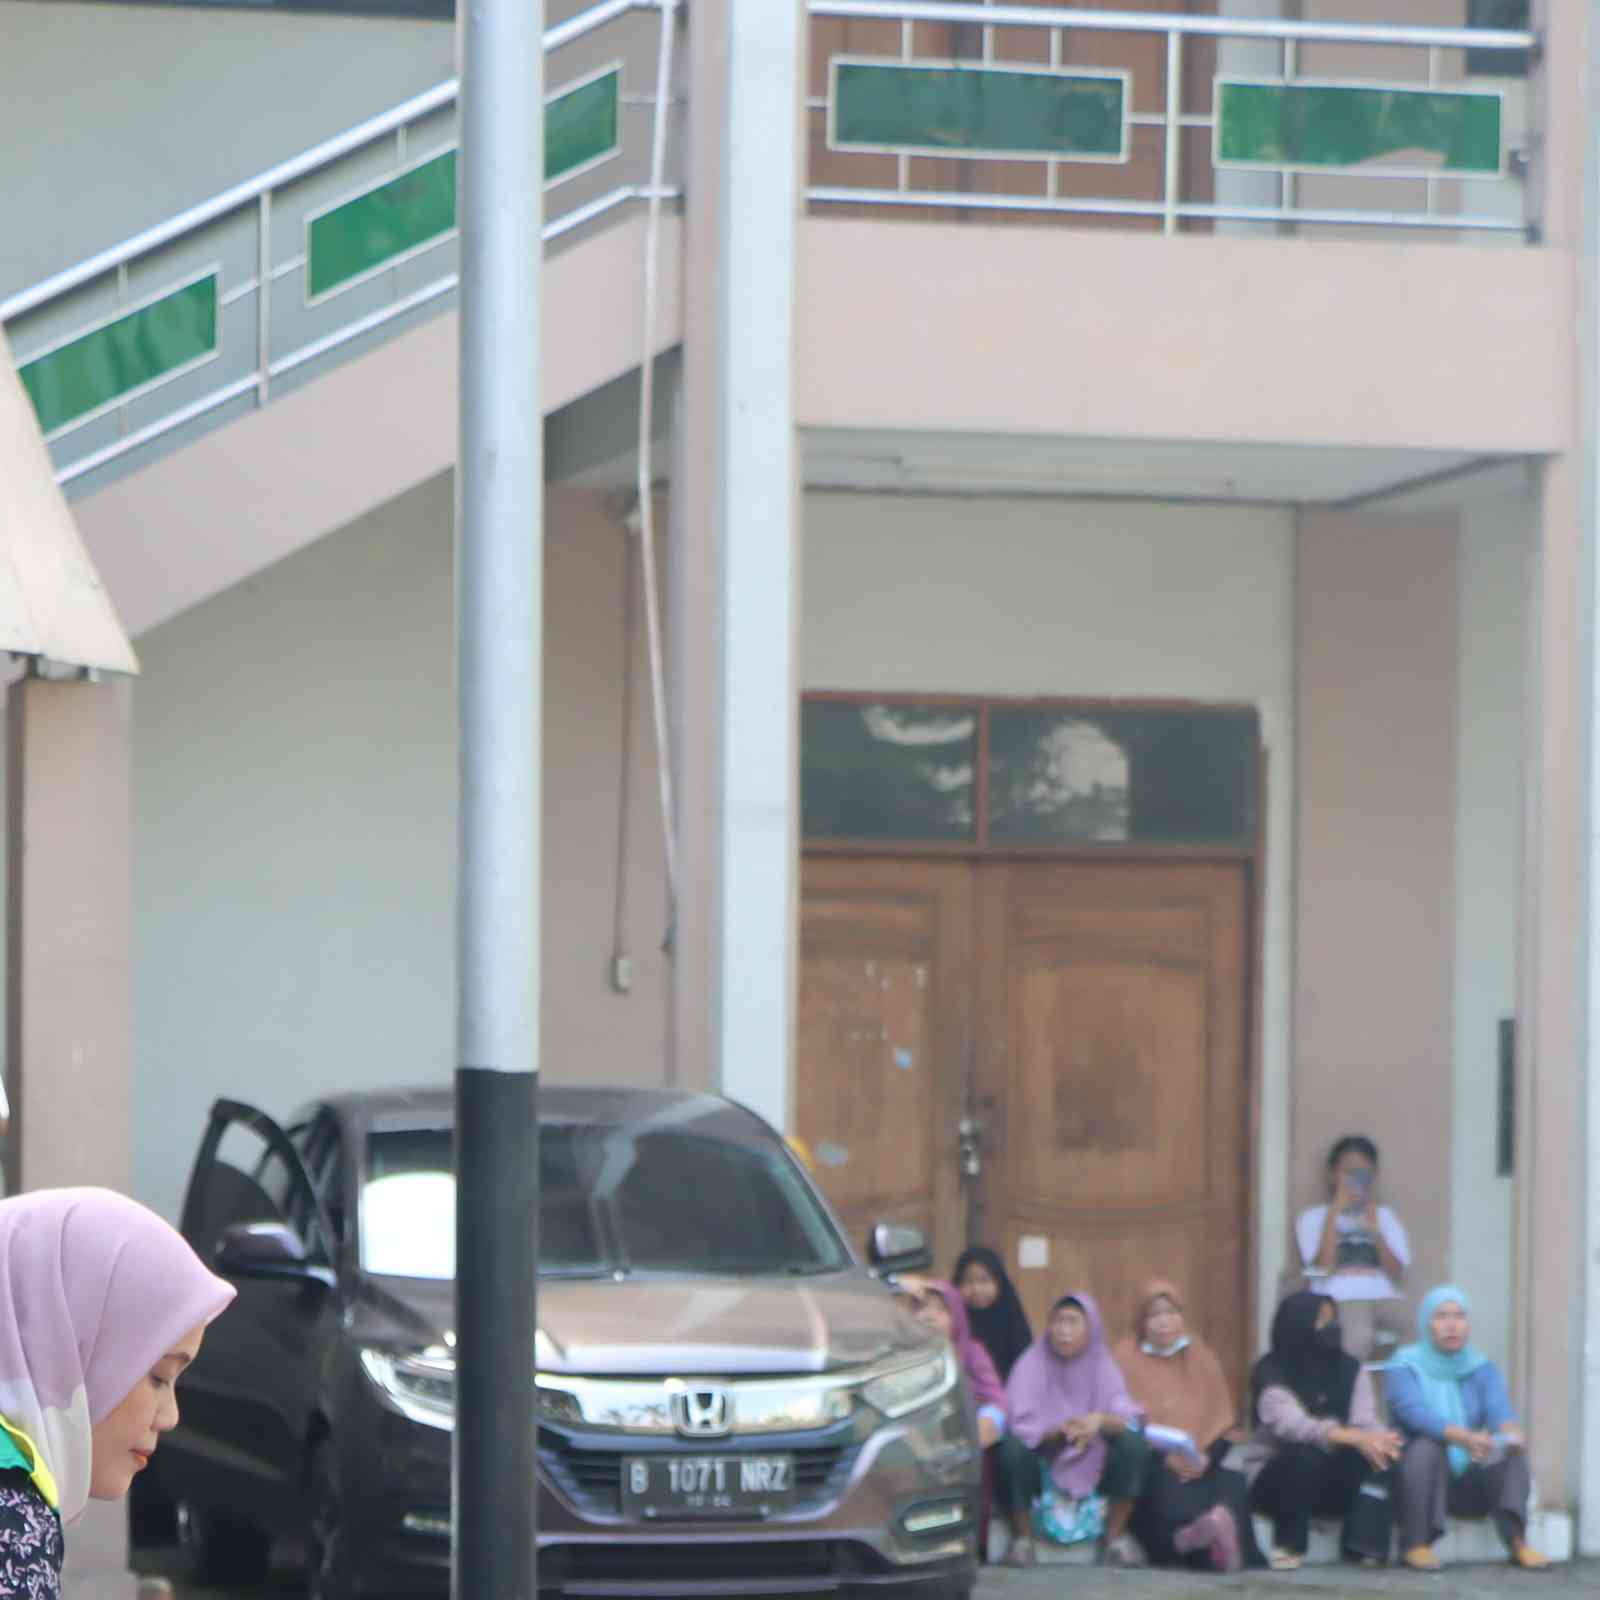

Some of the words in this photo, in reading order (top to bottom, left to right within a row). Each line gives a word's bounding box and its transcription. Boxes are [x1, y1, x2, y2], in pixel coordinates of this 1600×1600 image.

[629, 1459, 648, 1494] B
[668, 1458, 725, 1493] 1071
[739, 1458, 787, 1493] NRZ
